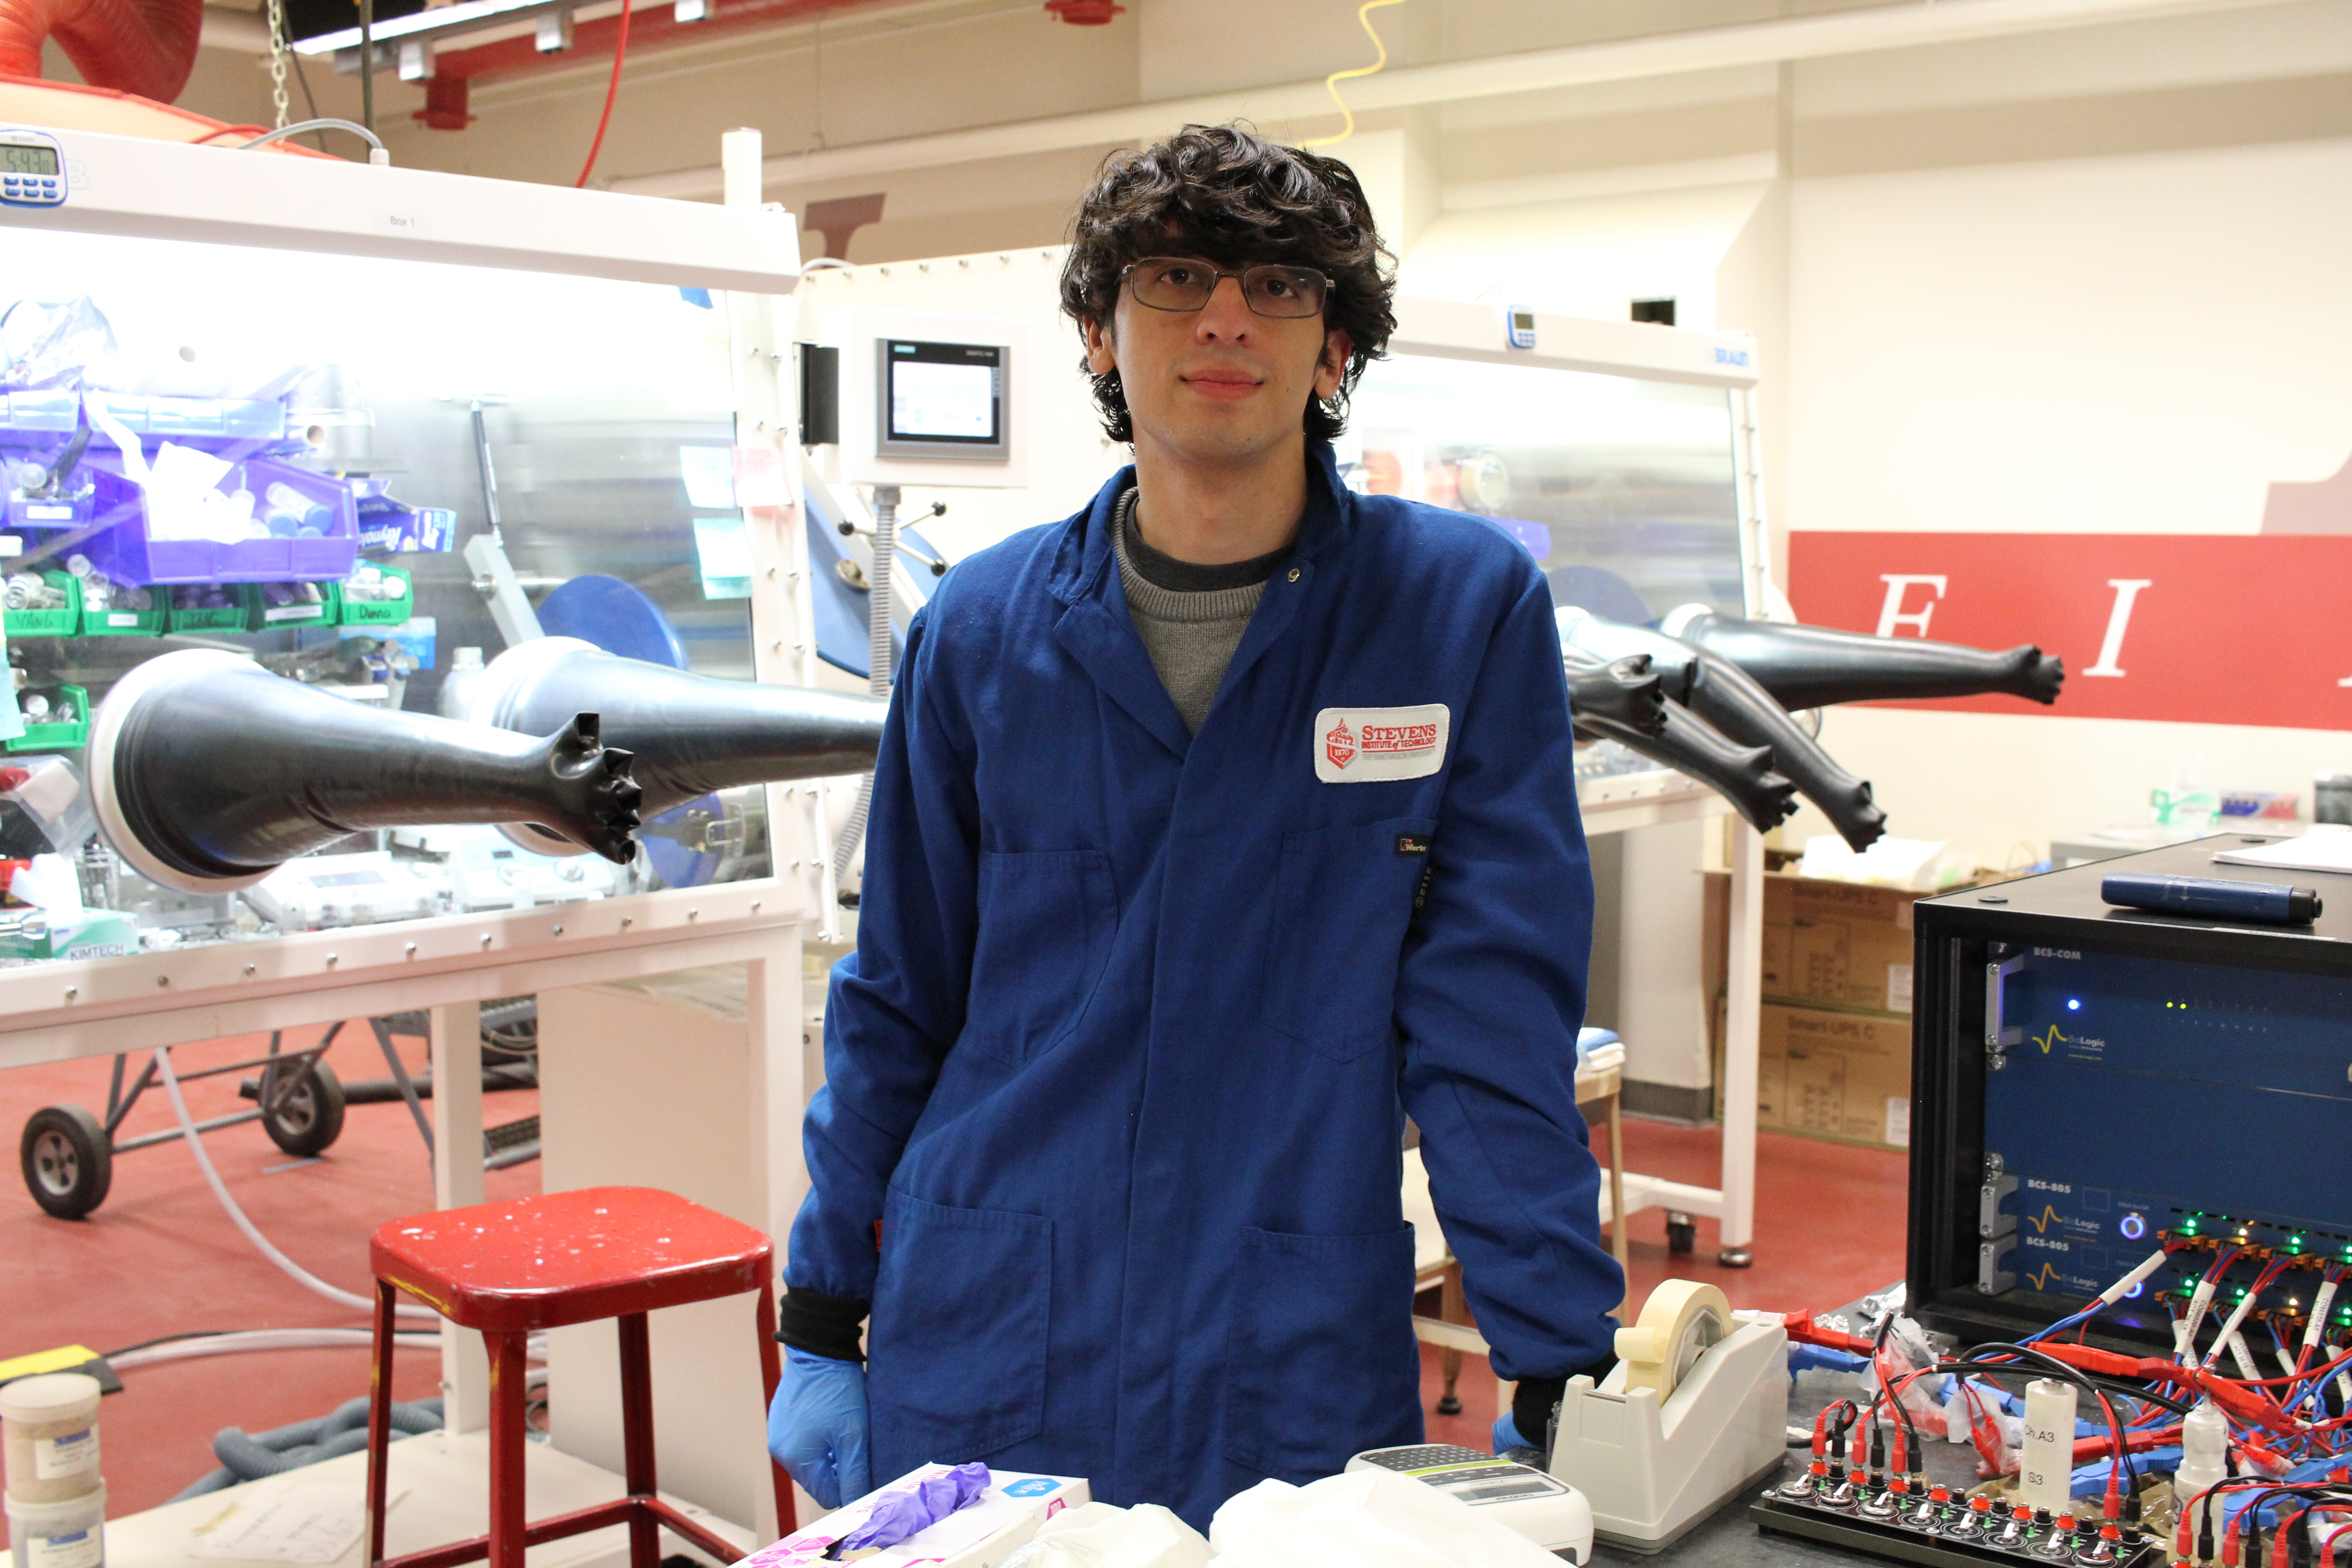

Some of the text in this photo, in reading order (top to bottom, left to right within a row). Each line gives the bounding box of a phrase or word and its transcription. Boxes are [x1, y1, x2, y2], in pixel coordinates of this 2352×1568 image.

[390, 215, 407, 226] Box
[2082, 578, 2152, 678] I
[1362, 724, 1436, 740] STEVENS
[1362, 736, 1437, 750] INSTITUTE of TECHNOLOGY
[70, 943, 124, 961] KIMTECH
[2034, 947, 2081, 960] BCS-COM
[2028, 1179, 2071, 1194] BCS-805
[2026, 1236, 2069, 1251] BCS-805
[2024, 1424, 2055, 1443] Ch.A3
[2028, 1471, 2043, 1485] S3
